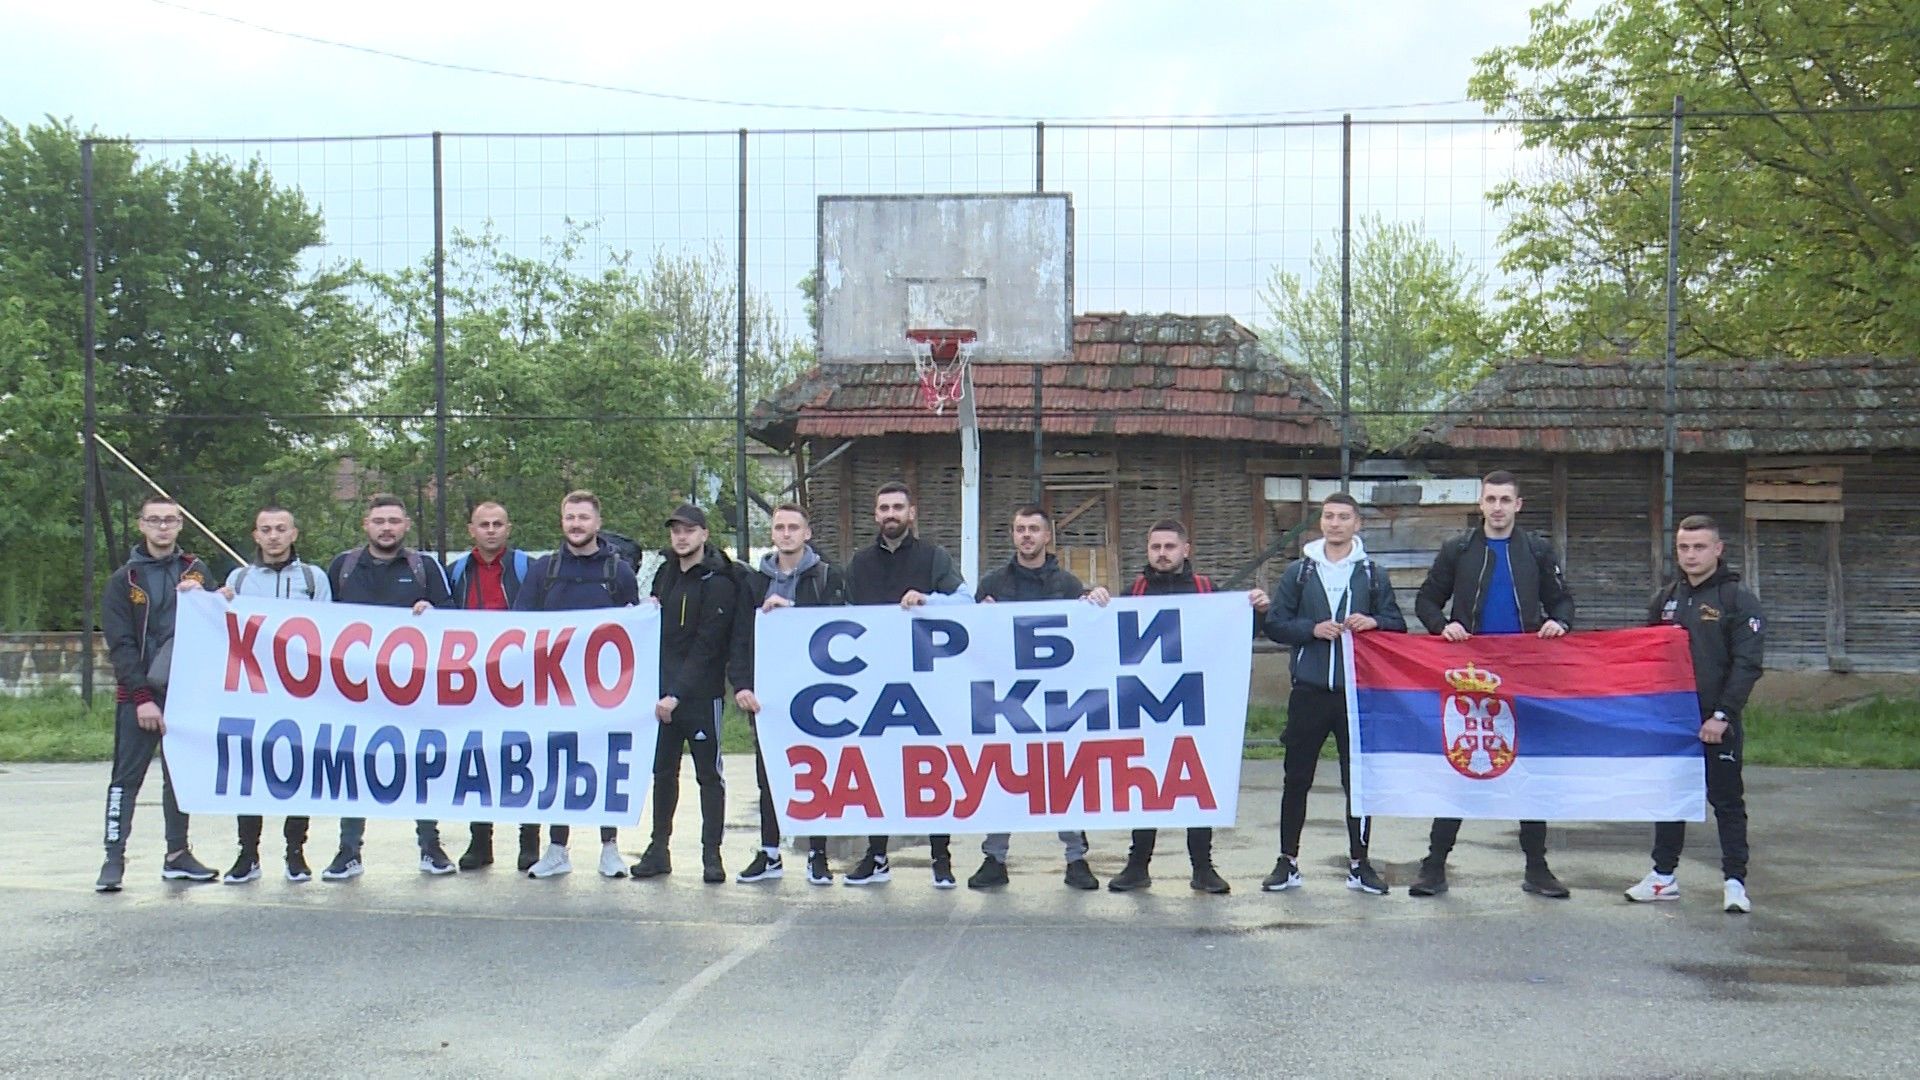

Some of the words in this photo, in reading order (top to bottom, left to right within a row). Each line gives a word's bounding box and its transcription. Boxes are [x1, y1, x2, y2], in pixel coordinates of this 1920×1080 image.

[223, 611, 635, 709] КОСОВСКО
[808, 608, 1183, 676] СРБИ
[789, 682, 942, 738] СА
[970, 671, 1206, 735] КиМ
[215, 716, 634, 812] ПОМОРАВЉЕ
[785, 744, 884, 820] ЗА
[902, 735, 1218, 819] ВУЧИЋА
